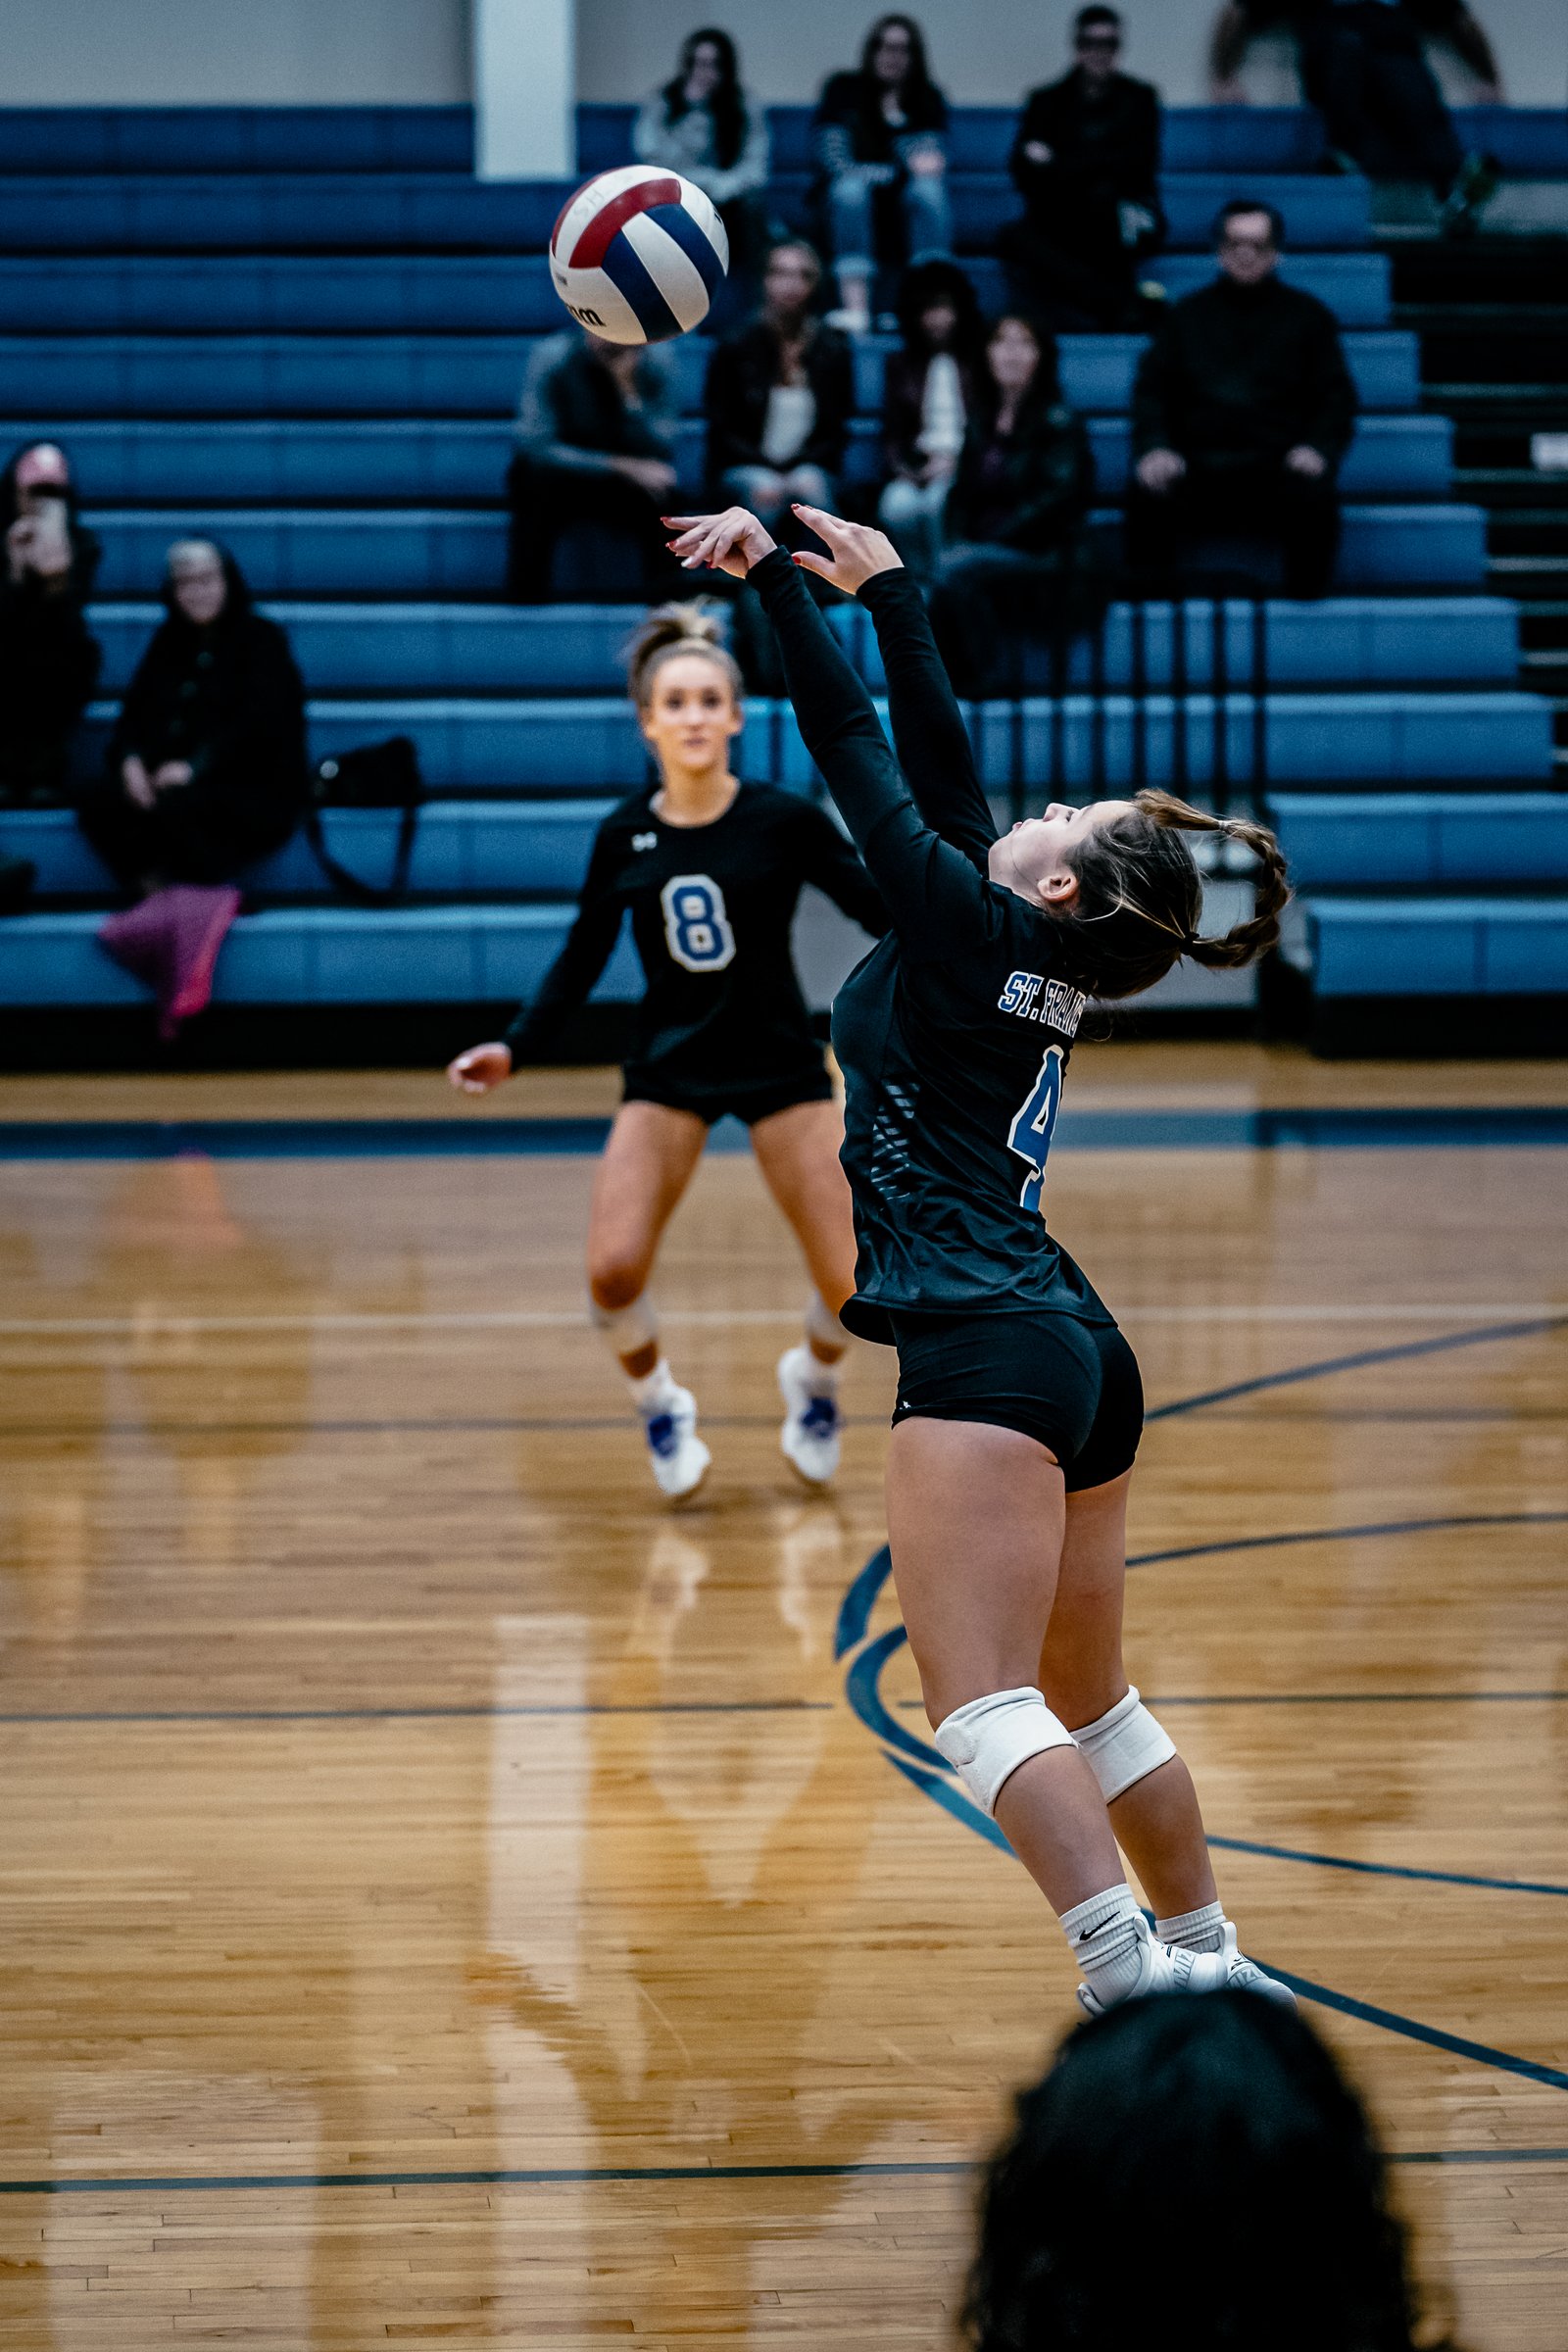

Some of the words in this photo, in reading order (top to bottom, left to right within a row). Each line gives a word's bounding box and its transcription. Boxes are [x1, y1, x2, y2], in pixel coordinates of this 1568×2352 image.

[660, 873, 736, 973] 8
[998, 970, 1045, 1021] ST.
[1006, 1044, 1064, 1213] 4
